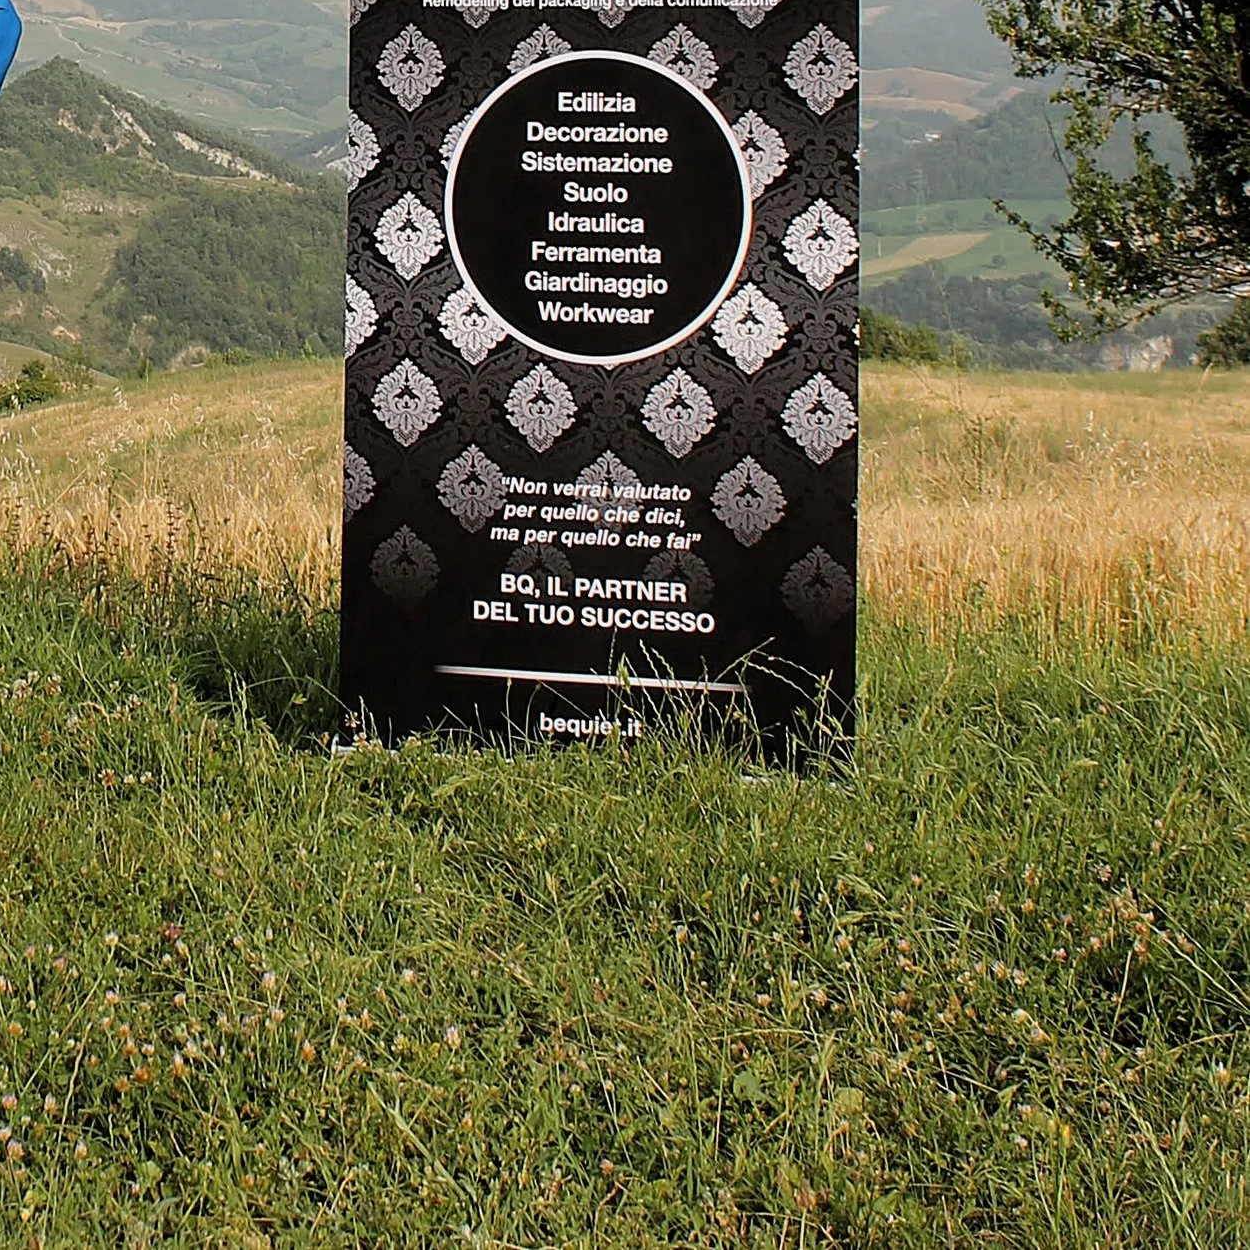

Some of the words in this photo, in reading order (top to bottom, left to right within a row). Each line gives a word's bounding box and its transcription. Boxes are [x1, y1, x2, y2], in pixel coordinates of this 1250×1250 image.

[557, 92, 636, 113] Edilizia
[526, 122, 669, 143] Decorazione
[521, 152, 672, 174] Sistemazione
[563, 183, 628, 203] Suolo
[548, 212, 645, 233] Idraulica
[531, 242, 661, 264] Ferramenta
[524, 272, 668, 298] Giardinaggio
[538, 302, 653, 324] Workwear
[552, 481, 608, 498] verrai
[612, 483, 691, 501] valutato
[503, 503, 537, 521] per
[540, 504, 600, 523] quello
[604, 506, 639, 524] che
[643, 507, 686, 527] dici,
[490, 528, 519, 543] ma
[523, 529, 557, 547] per
[561, 529, 620, 548] quello
[624, 531, 661, 549] che
[500, 574, 541, 599] BQ,
[547, 576, 569, 598] IL
[574, 578, 687, 602] PARTNER
[473, 600, 519, 622] DEL
[526, 603, 575, 626] TUO
[581, 607, 715, 633] SUCCESSO
